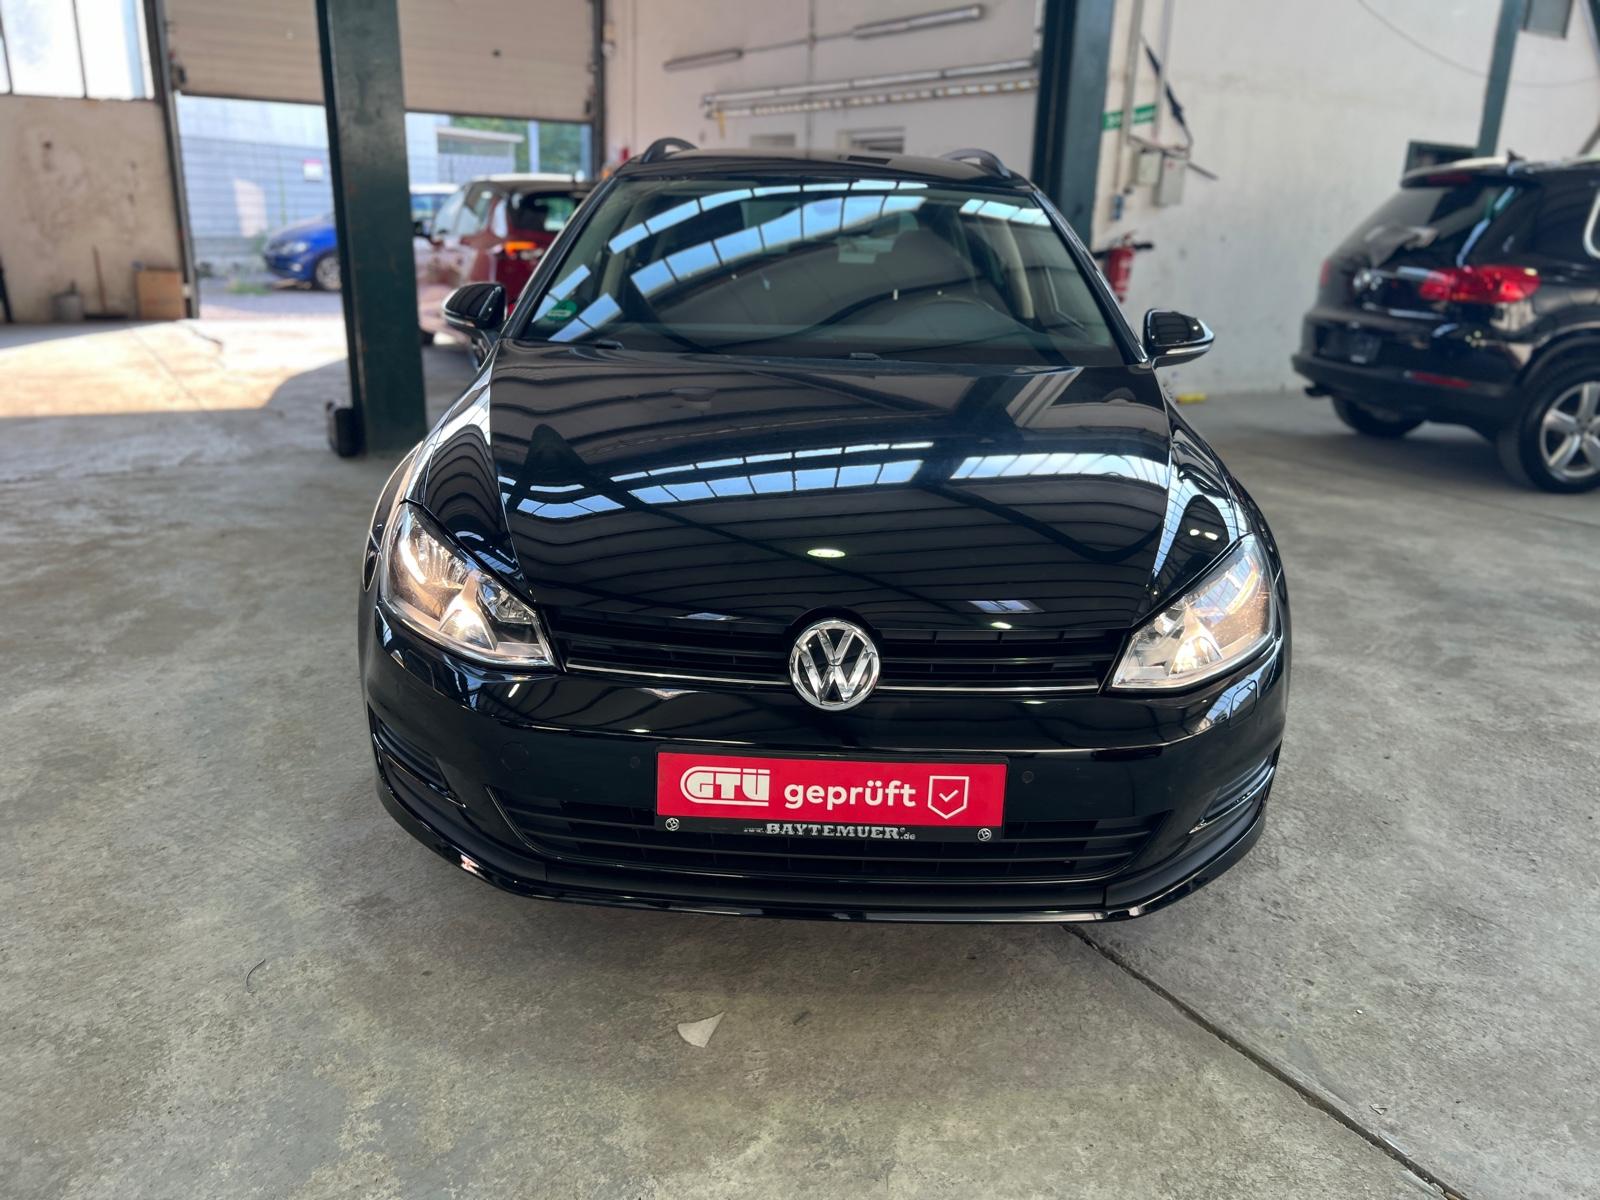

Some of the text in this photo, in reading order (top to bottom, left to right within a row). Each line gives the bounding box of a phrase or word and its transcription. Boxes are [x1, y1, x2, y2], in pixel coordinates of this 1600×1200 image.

[789, 620, 880, 711] VW
[680, 766, 916, 810] GTÜ geprüft
